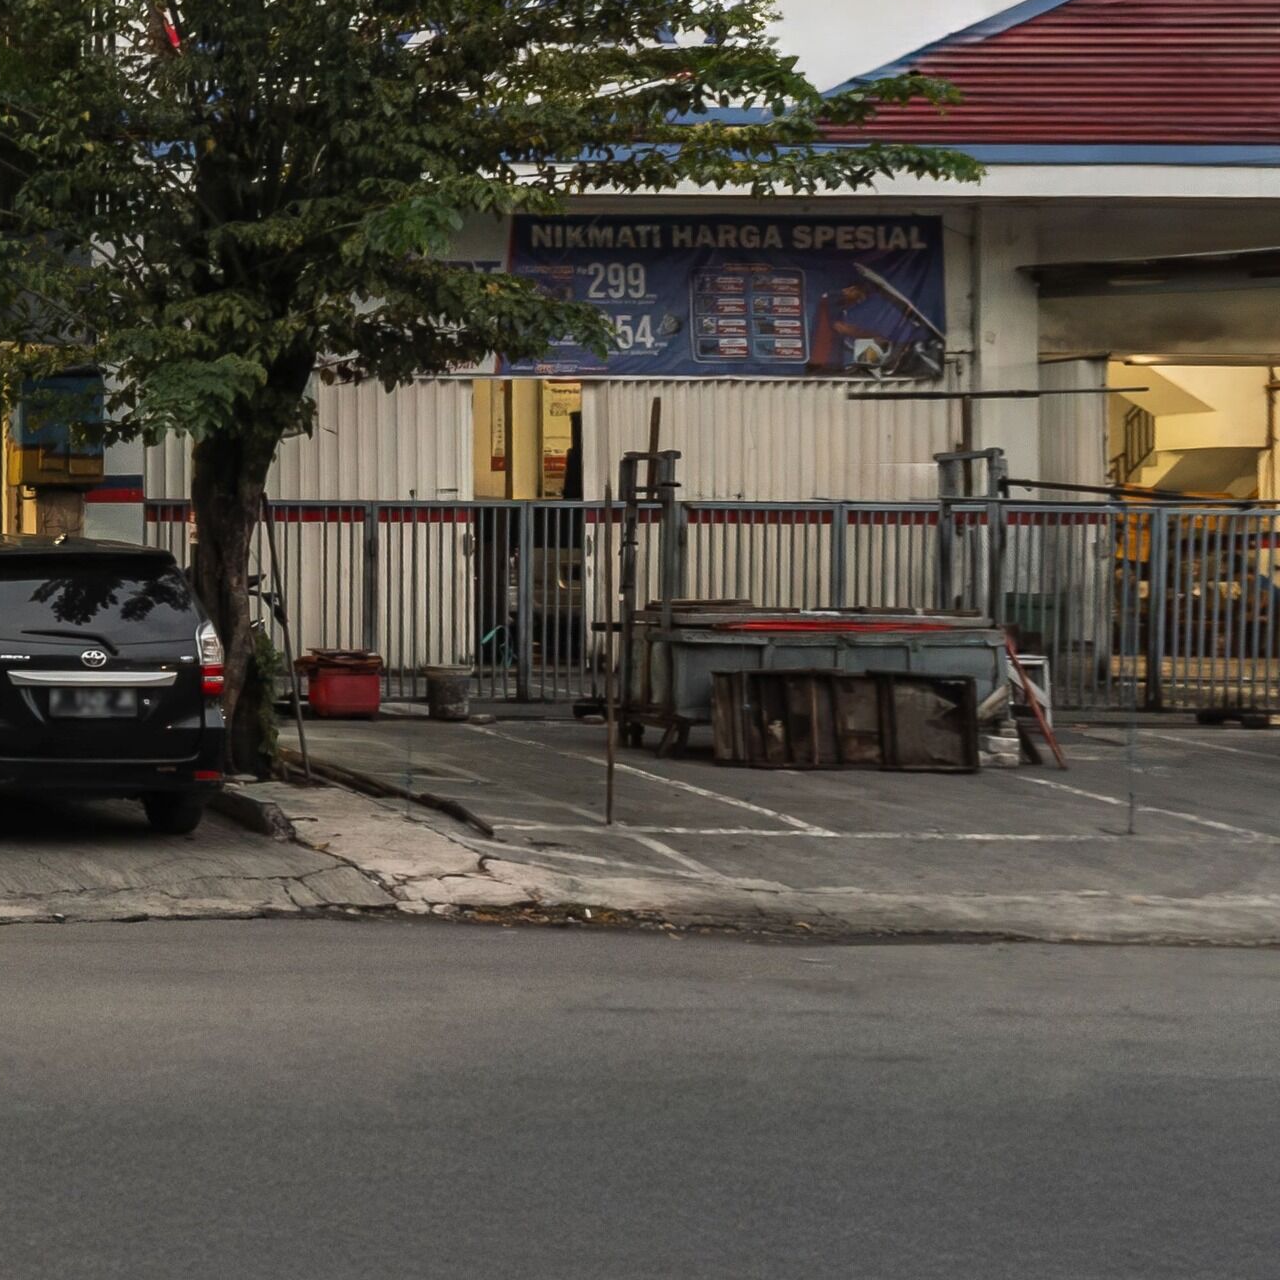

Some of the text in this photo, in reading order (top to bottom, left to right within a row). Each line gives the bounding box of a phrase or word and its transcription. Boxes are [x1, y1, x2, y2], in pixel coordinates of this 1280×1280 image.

[531, 224, 927, 250] NIKMATI HARGA SPESIAL
[588, 262, 646, 299] 299
